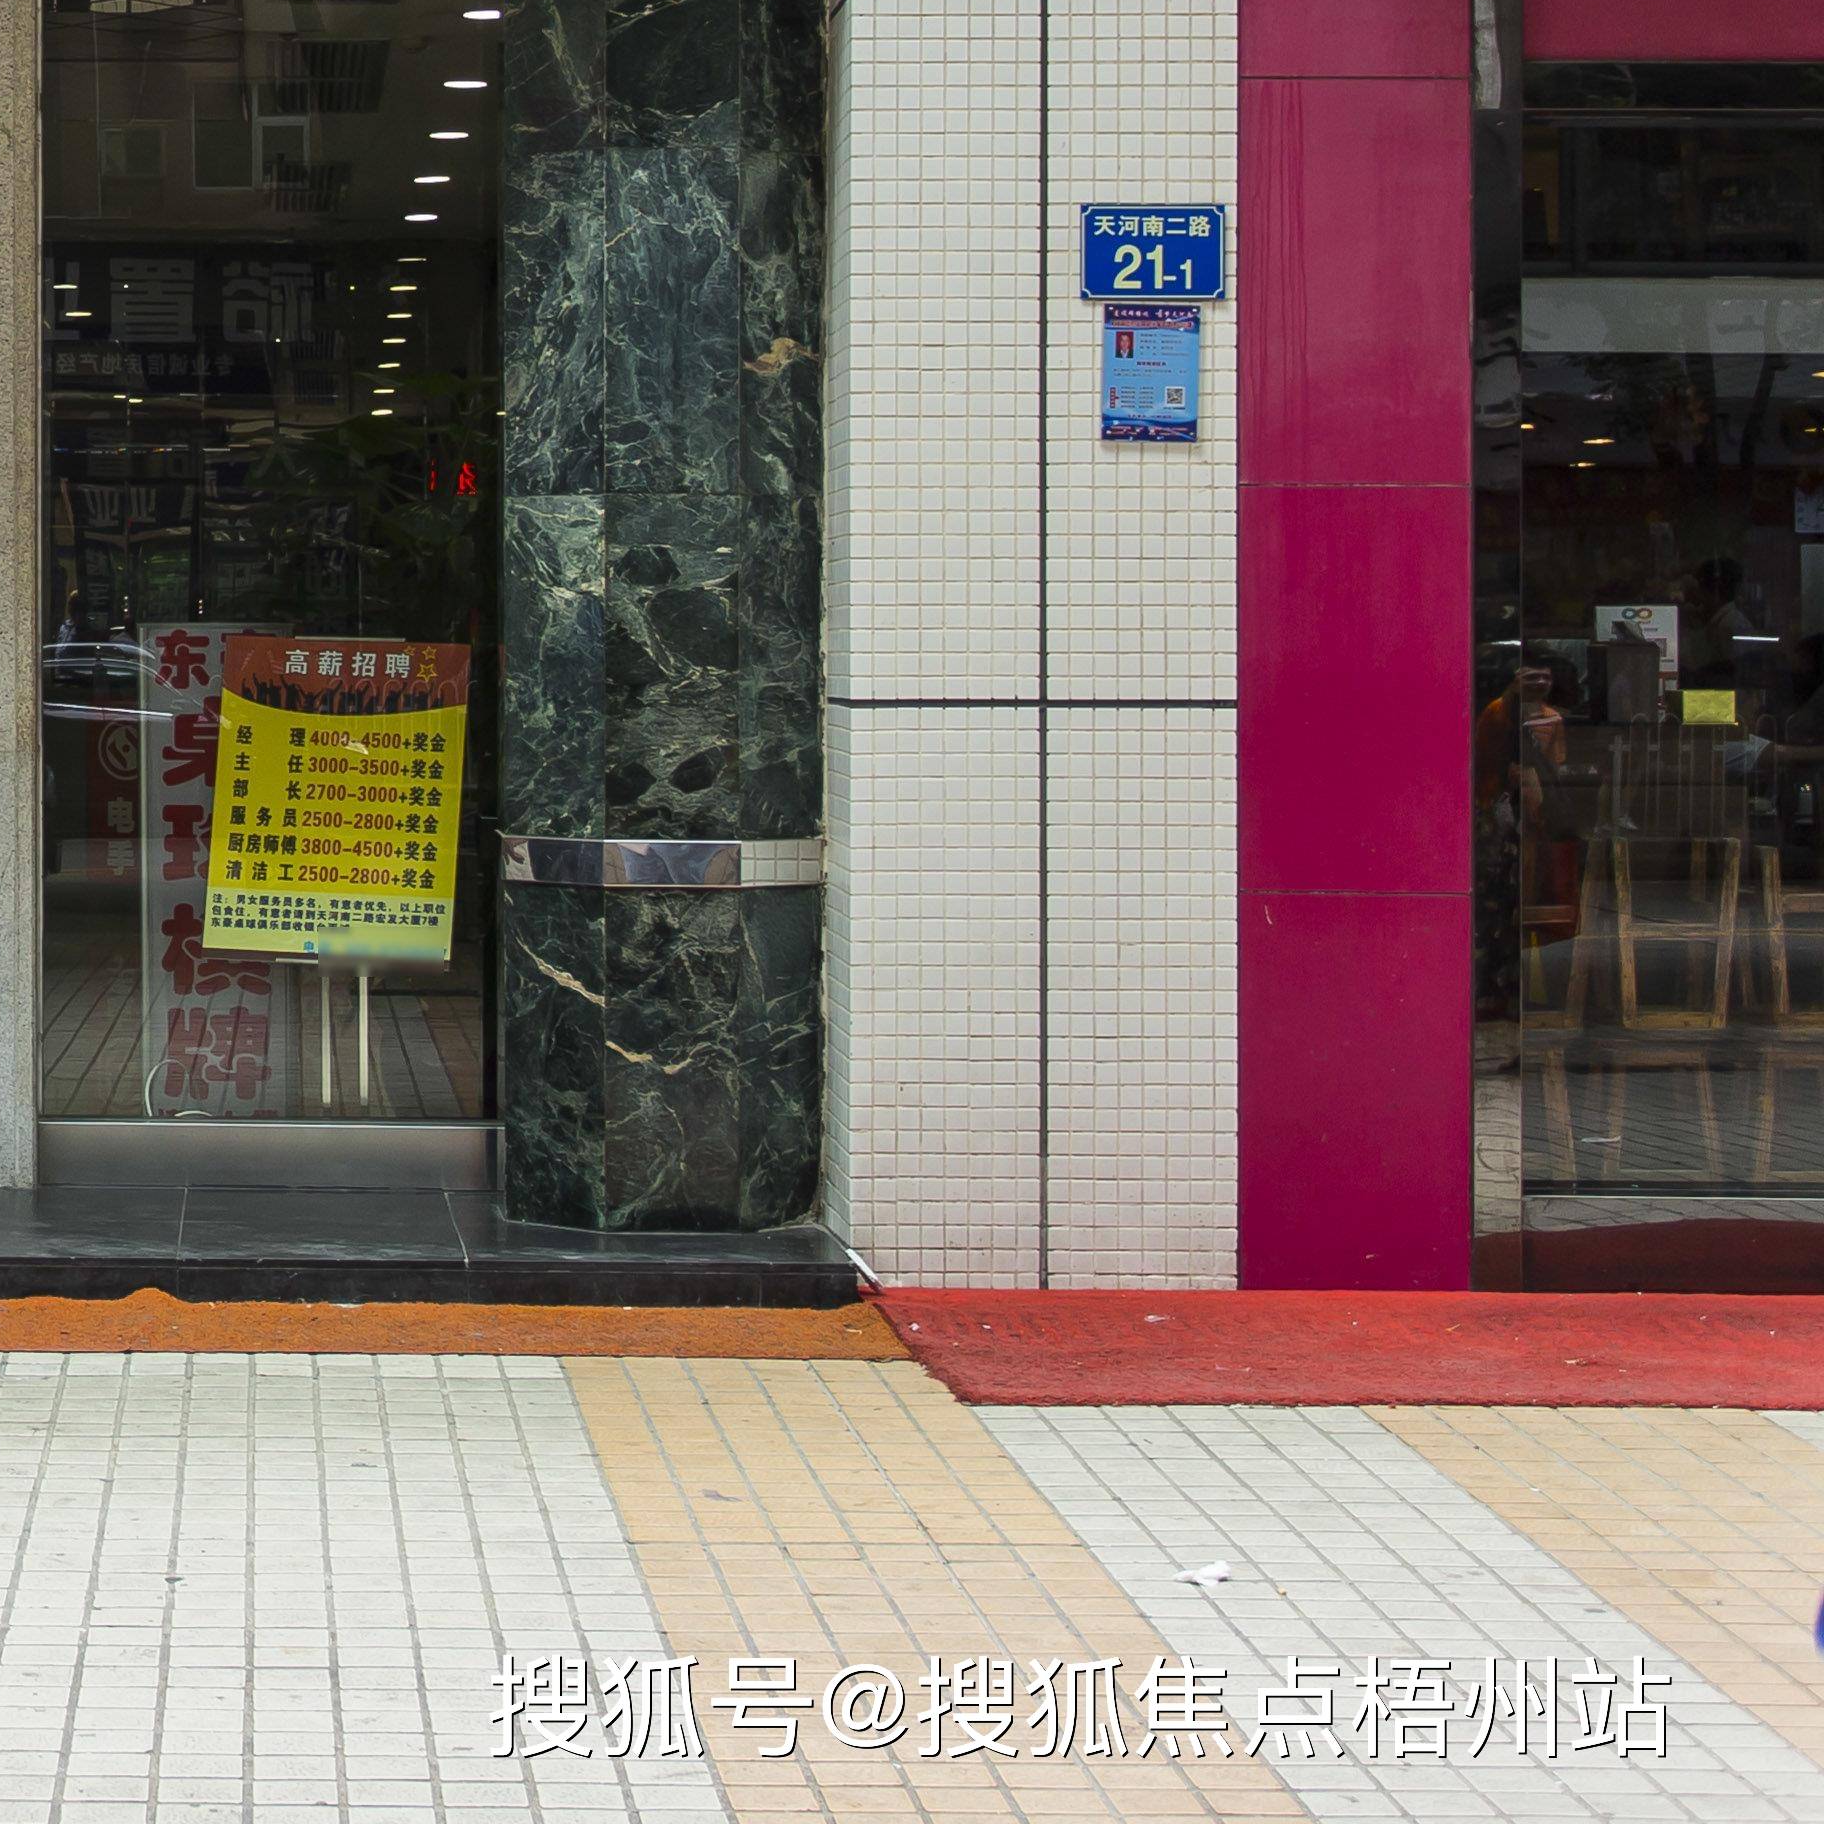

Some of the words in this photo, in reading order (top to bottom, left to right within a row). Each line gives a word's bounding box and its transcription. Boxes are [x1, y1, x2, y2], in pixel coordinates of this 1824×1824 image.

[1093, 215, 1211, 238] 天河南二路
[1113, 243, 1192, 290] 21-1
[284, 648, 413, 679] 高薪招聘
[235, 725, 306, 748] 经理
[233, 751, 304, 774] 主任
[232, 778, 302, 801] 部长
[229, 805, 297, 828] 服务员
[227, 832, 298, 856] 厨房师傅
[225, 859, 294, 882] 清洁工
